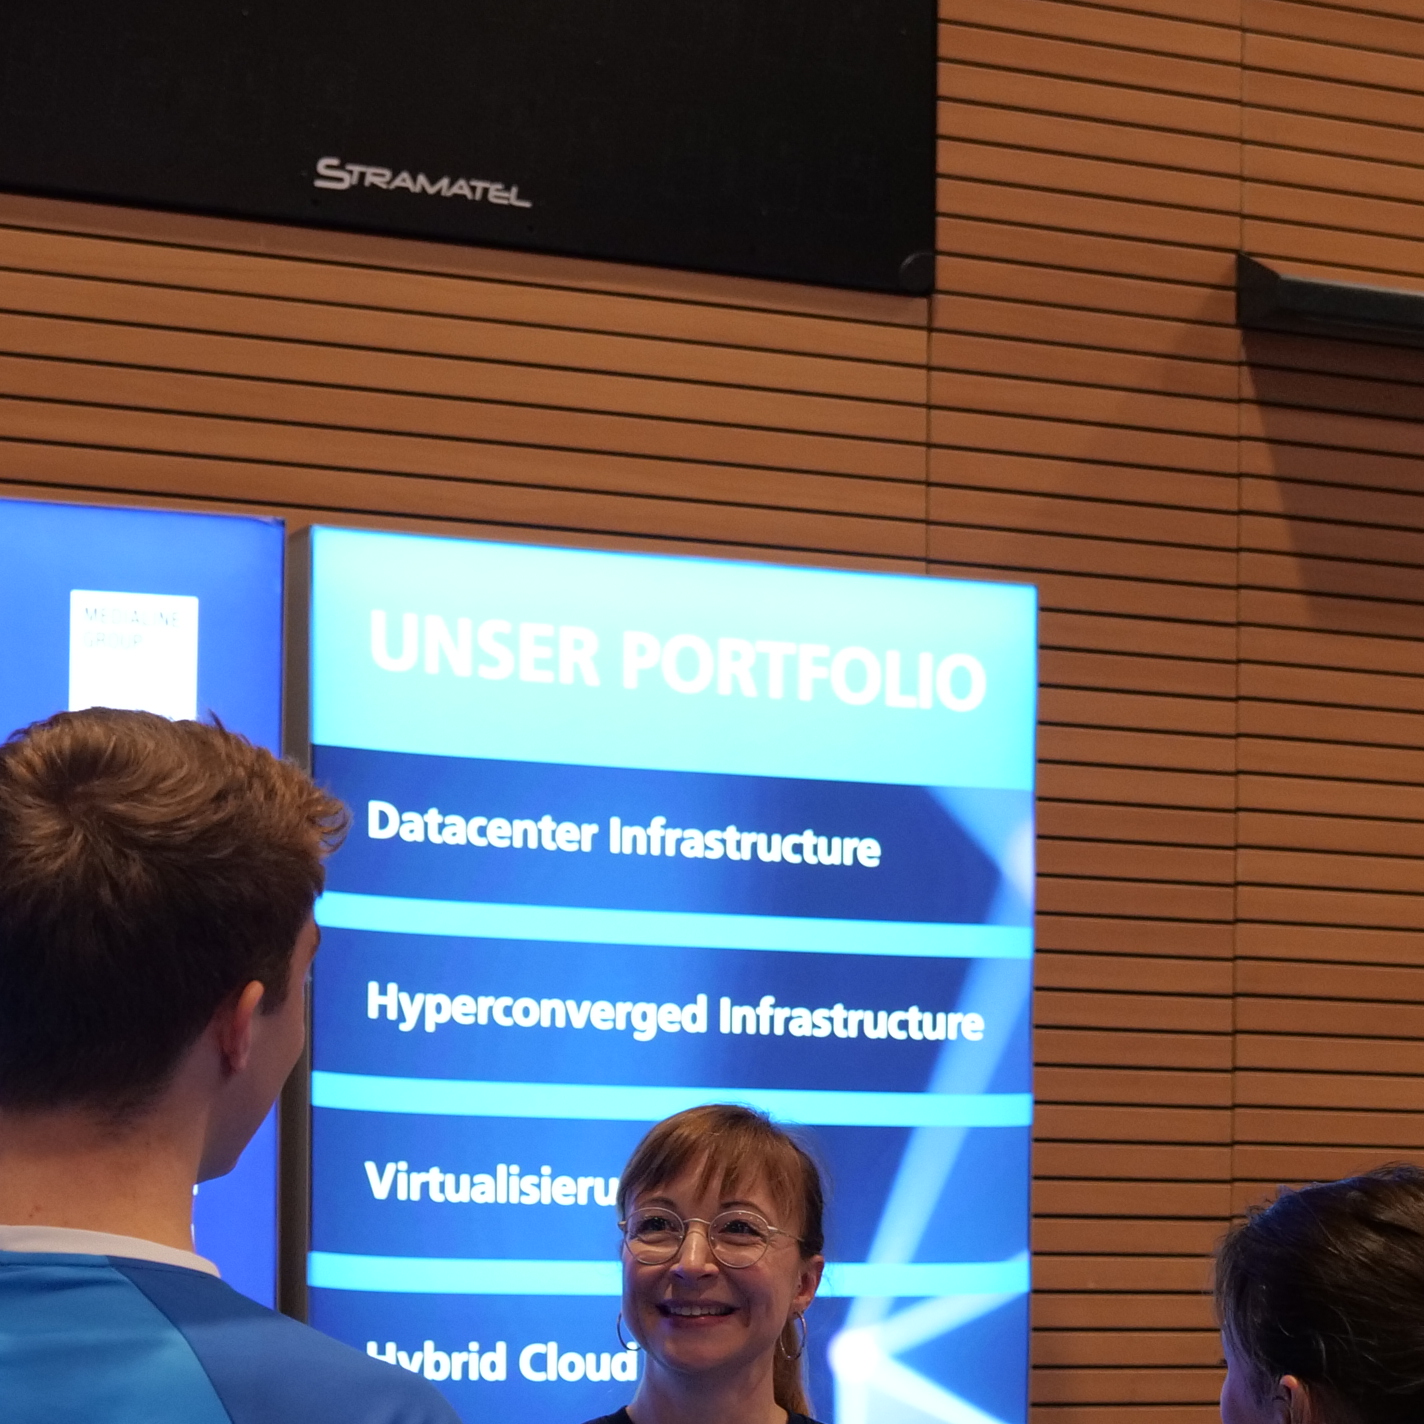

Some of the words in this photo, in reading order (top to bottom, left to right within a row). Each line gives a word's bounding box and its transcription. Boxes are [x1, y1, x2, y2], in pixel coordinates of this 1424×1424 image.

[314, 157, 532, 208] STRAMATEL
[371, 610, 600, 687] UNSER
[622, 631, 988, 714] PORTFOLIO
[366, 801, 598, 855] Datacenter
[608, 815, 883, 869] Infrastructure
[366, 982, 708, 1042] Hyperconverged
[719, 995, 986, 1042] Infrastructure
[364, 1161, 619, 1207] Virtualisieru
[519, 1341, 639, 1382] Cloud
